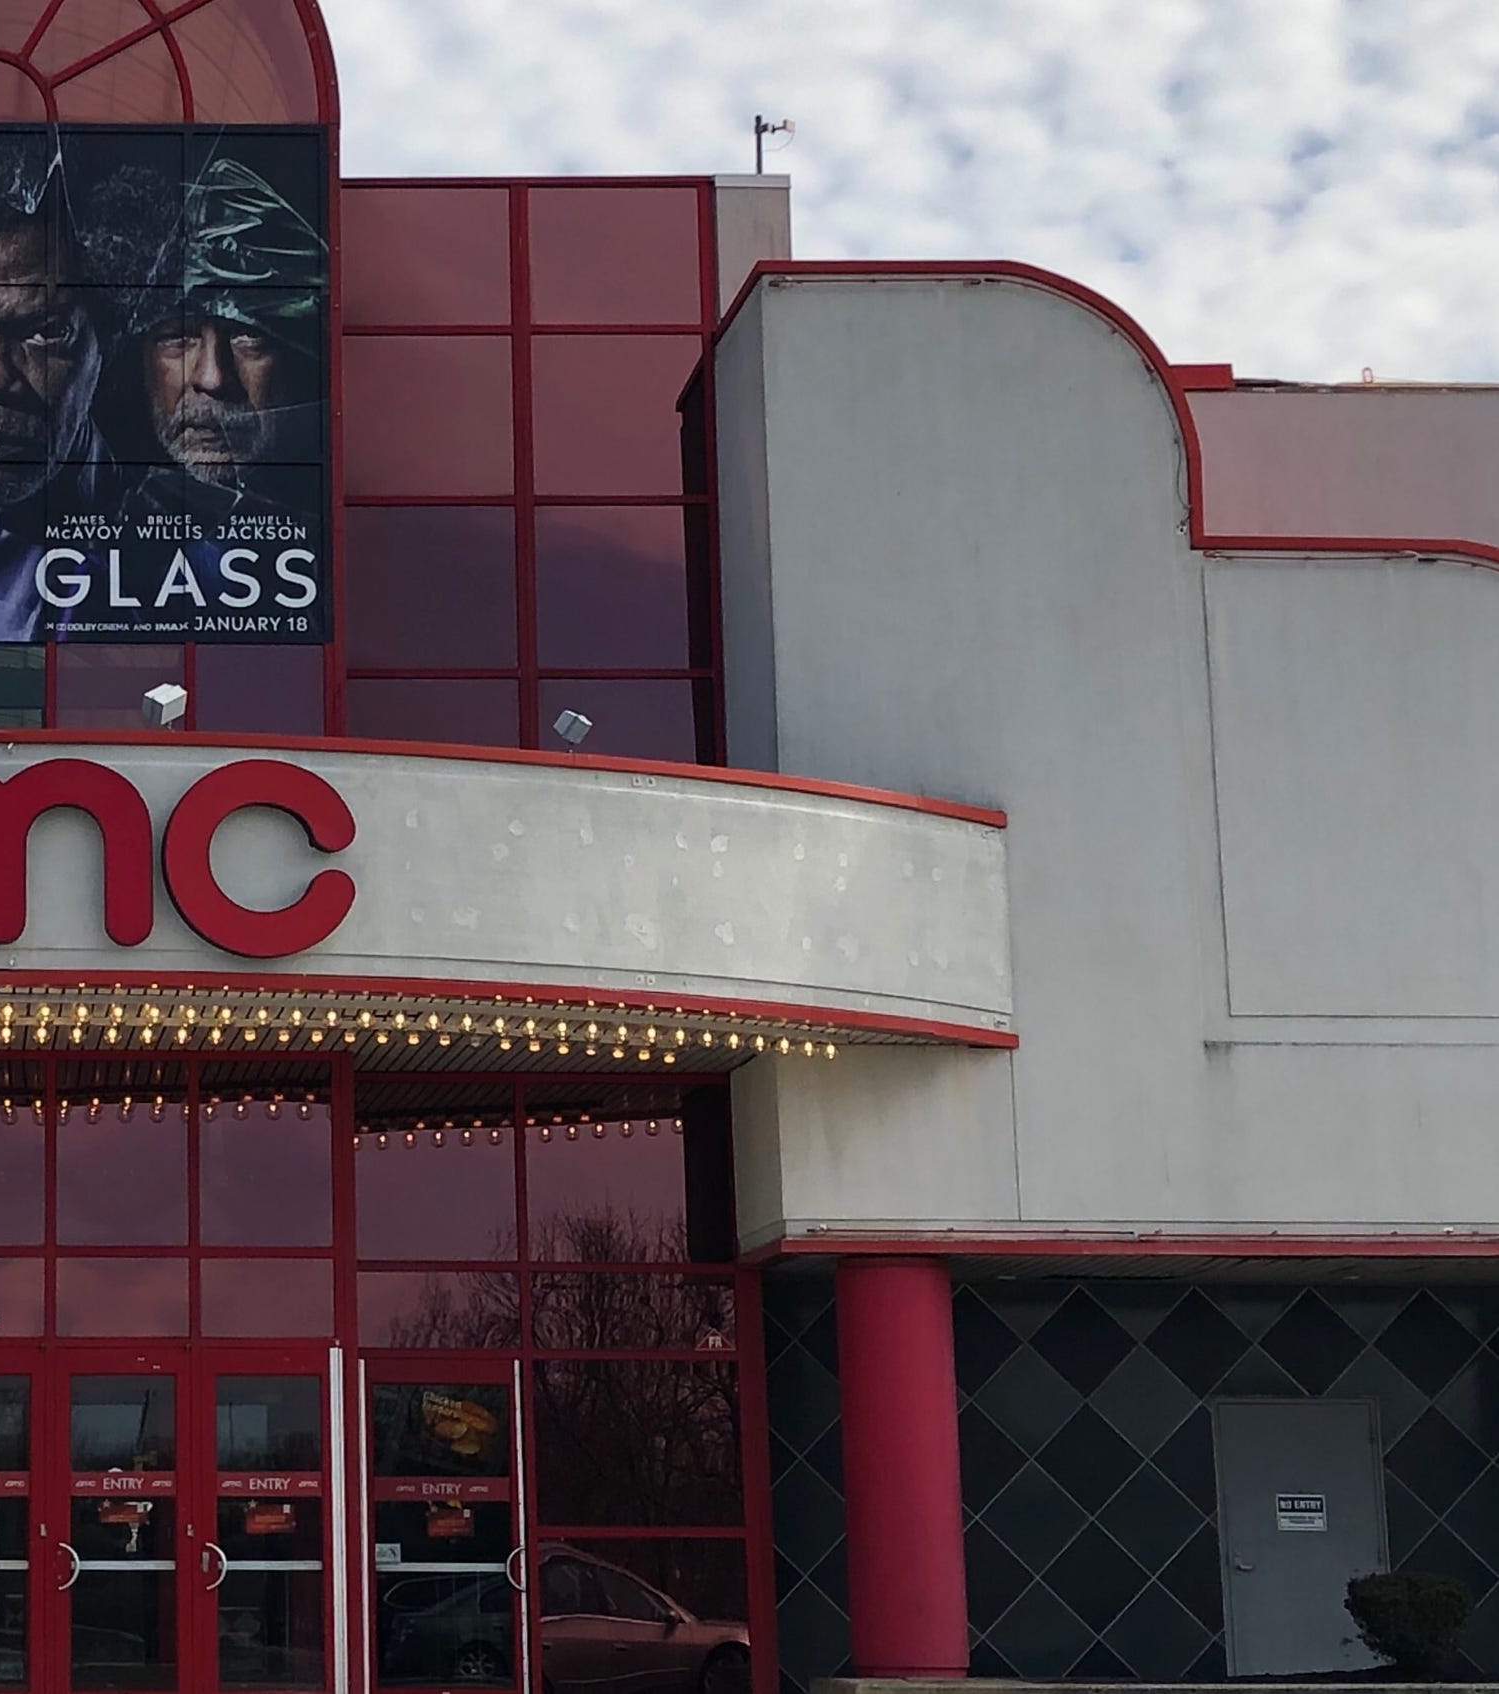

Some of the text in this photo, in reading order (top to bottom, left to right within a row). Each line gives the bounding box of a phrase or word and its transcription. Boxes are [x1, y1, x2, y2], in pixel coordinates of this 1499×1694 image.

[62, 515, 106, 525] JAMES
[147, 514, 192, 525] BRUCE
[230, 515, 282, 526] SAMUEL
[136, 525, 203, 540] WILLIS
[216, 525, 306, 540] JACKSON
[35, 548, 317, 608] GLASS
[194, 616, 308, 631] JANUARY 18
[103, 1478, 145, 1490] ENTRY
[249, 1478, 291, 1490] ENTRY
[422, 1483, 462, 1495] ENTRY
